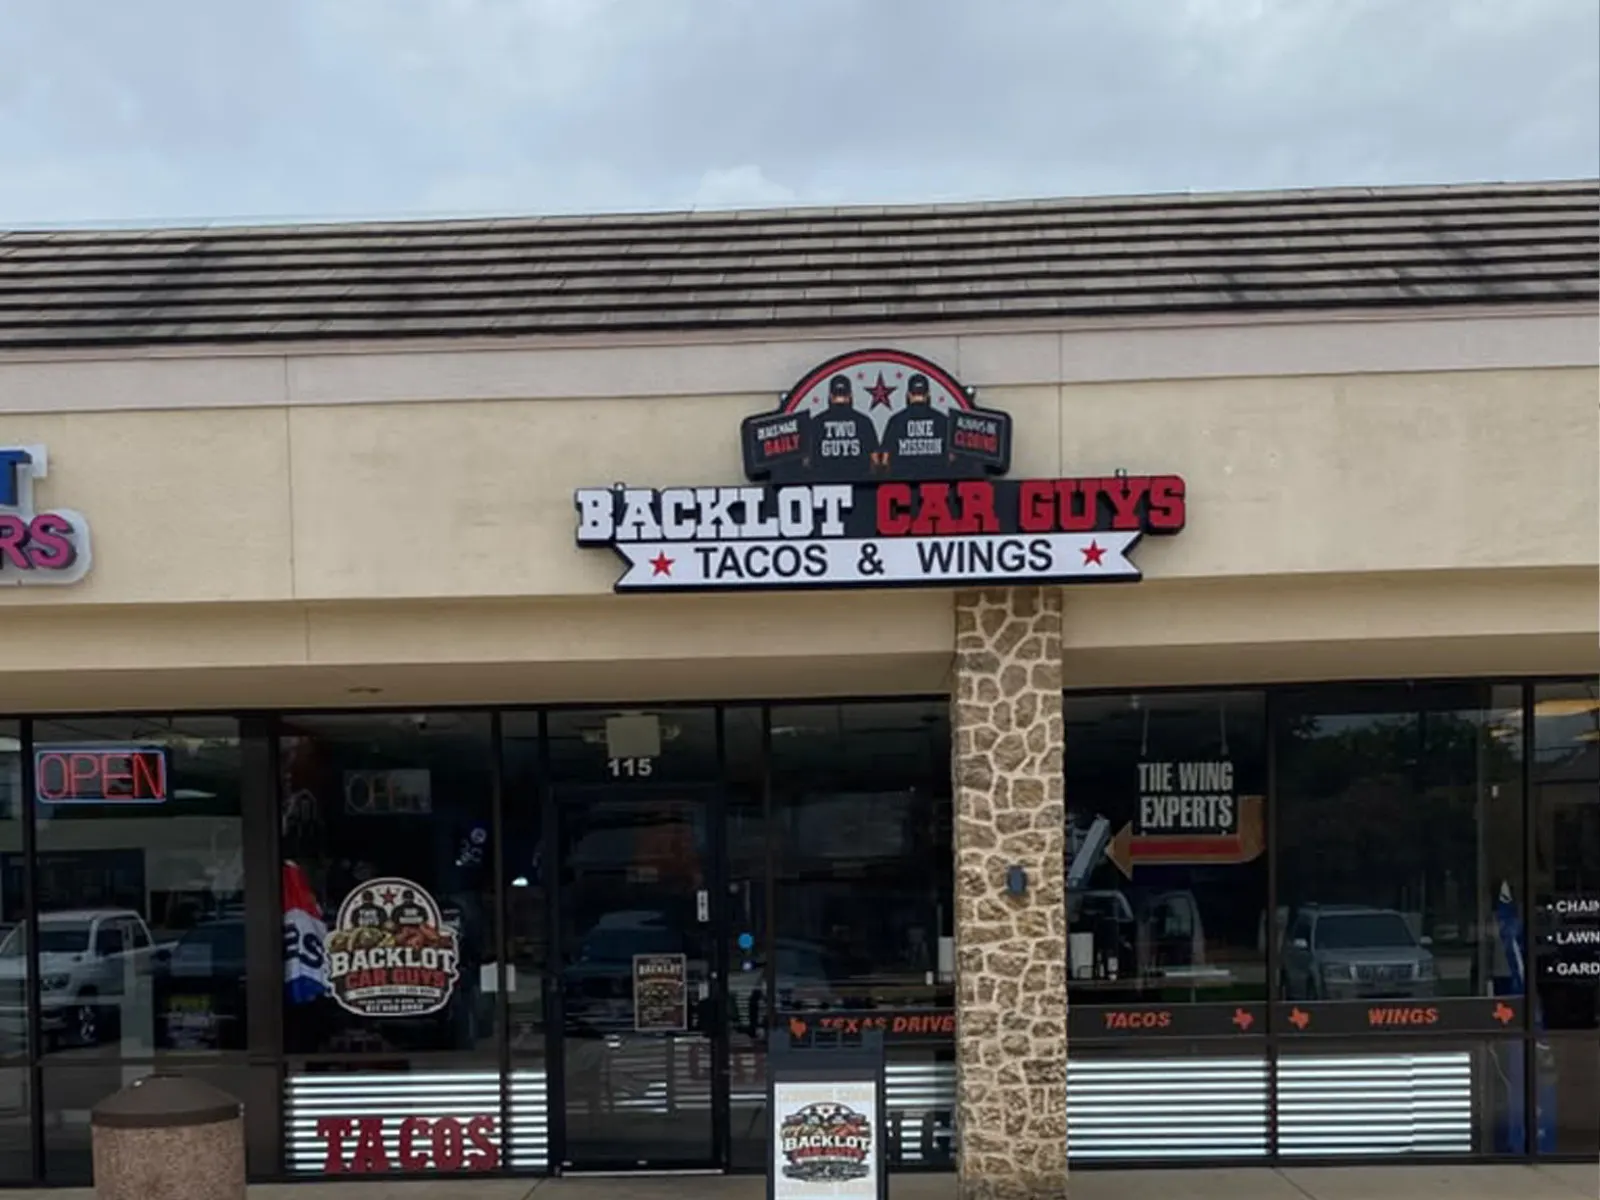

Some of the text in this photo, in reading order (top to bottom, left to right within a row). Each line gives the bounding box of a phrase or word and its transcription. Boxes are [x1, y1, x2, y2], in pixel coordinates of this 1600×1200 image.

[824, 421, 857, 437] TWO
[907, 420, 934, 436] ONE
[821, 440, 861, 456] GUYS
[898, 438, 943, 456] MISSION
[576, 475, 1185, 541] BACKLOT CAR GUYS
[694, 539, 1054, 580] TACOS & WINGS
[40, 753, 164, 799] OPEN
[607, 758, 653, 777] 115
[1137, 760, 1234, 792] THE WING
[1140, 795, 1233, 828] EXPERTS
[331, 948, 454, 978] BACKLOT
[346, 967, 445, 988] CAR GUYS
[1104, 1011, 1172, 1029] TACOS
[1367, 1006, 1439, 1025] WINGS
[317, 1115, 502, 1173] TACOS
[784, 1135, 872, 1152] BACKLOT
